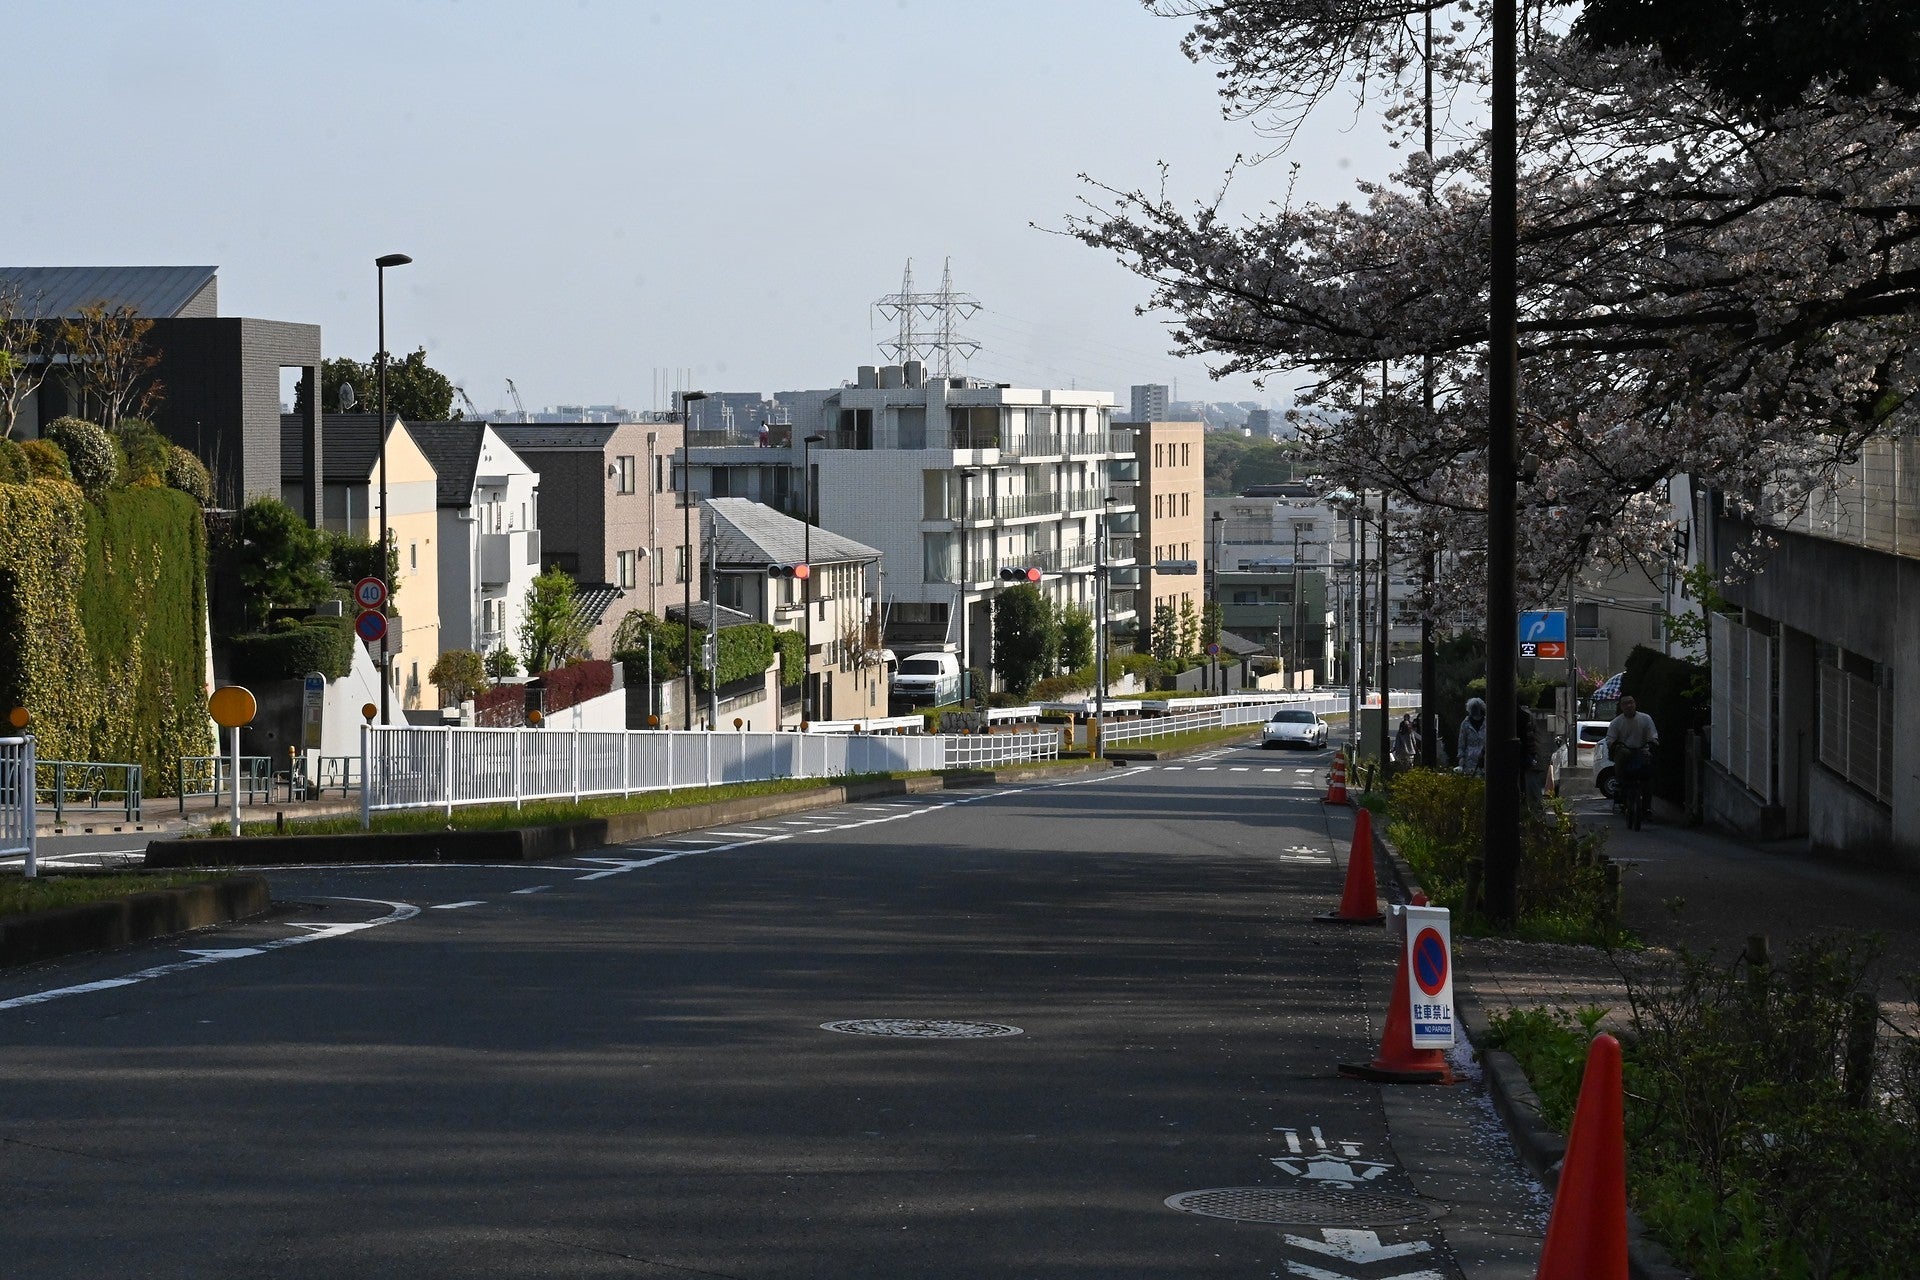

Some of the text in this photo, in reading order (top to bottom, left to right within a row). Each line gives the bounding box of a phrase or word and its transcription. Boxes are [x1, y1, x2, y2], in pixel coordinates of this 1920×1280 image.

[362, 586, 379, 600] 40
[1521, 642, 1536, 657] 空
[1413, 1004, 1451, 1020] 駐車禁止
